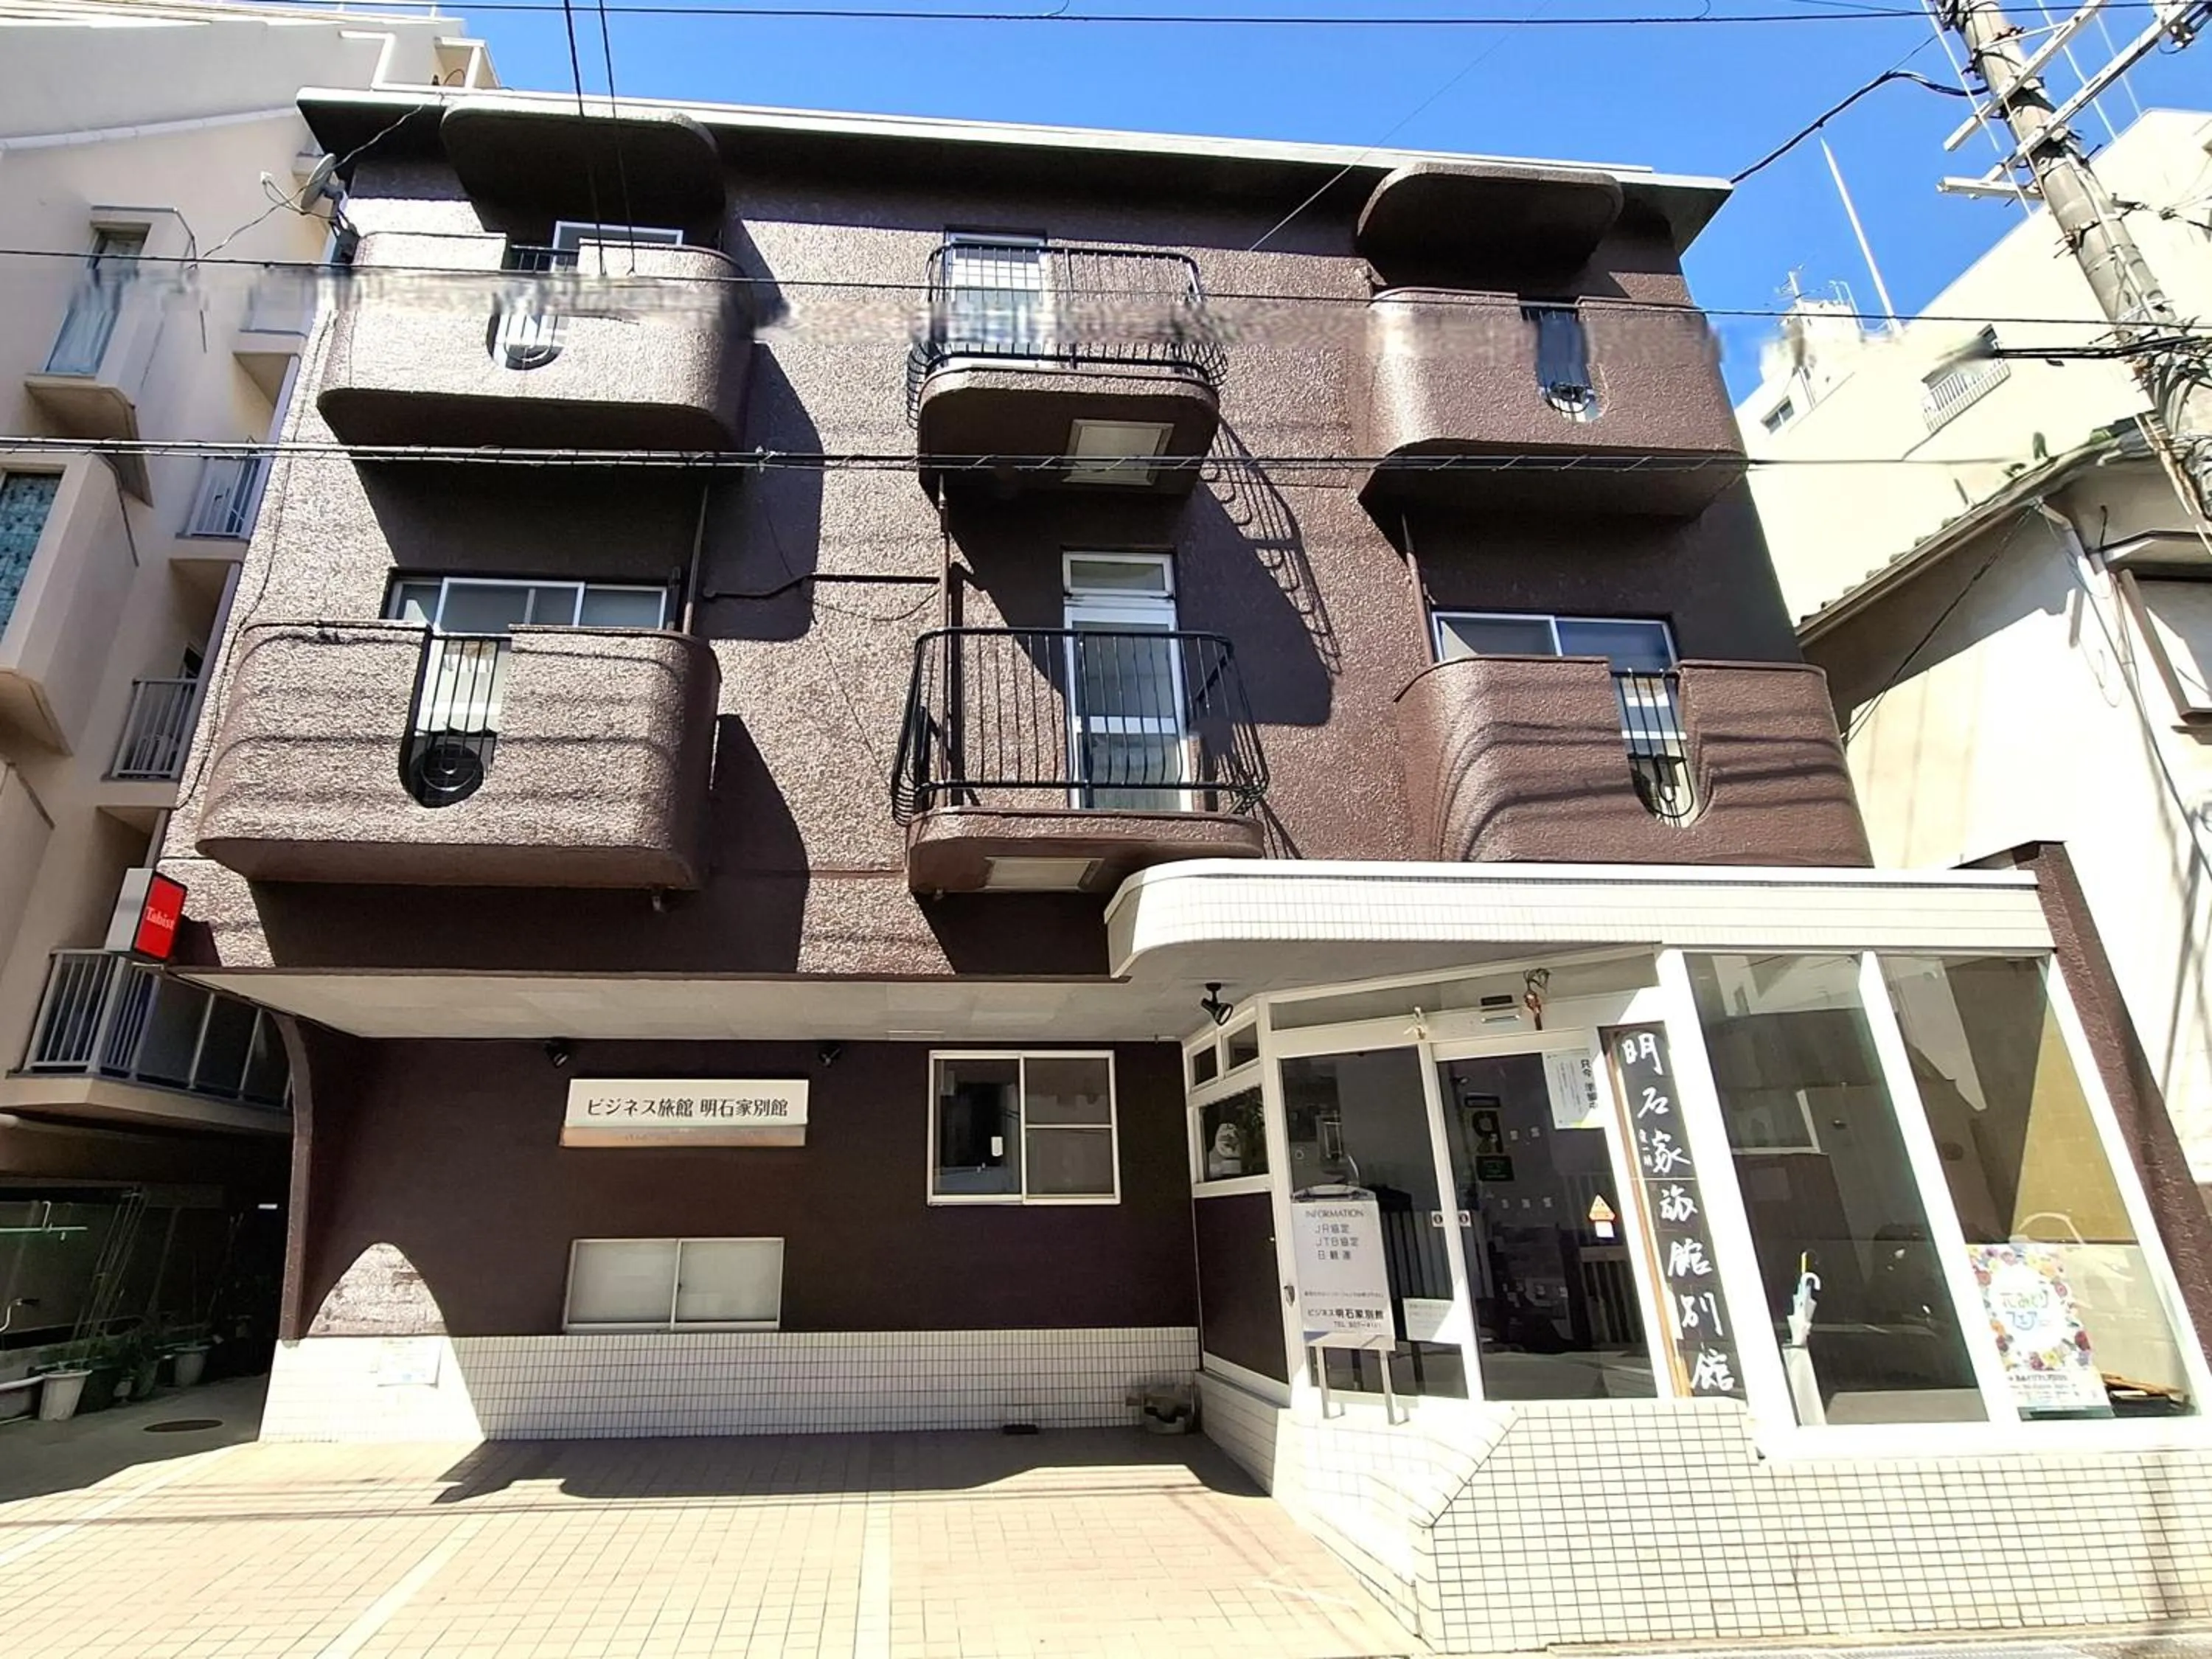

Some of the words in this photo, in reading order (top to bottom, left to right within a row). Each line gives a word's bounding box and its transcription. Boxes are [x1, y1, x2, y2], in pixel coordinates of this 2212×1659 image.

[145, 906, 175, 931] Tabist
[587, 1097, 693, 1118] ビジネス旅館
[699, 1098, 789, 1117] 明石家別館
[1305, 1208, 1364, 1218] INFORMATION
